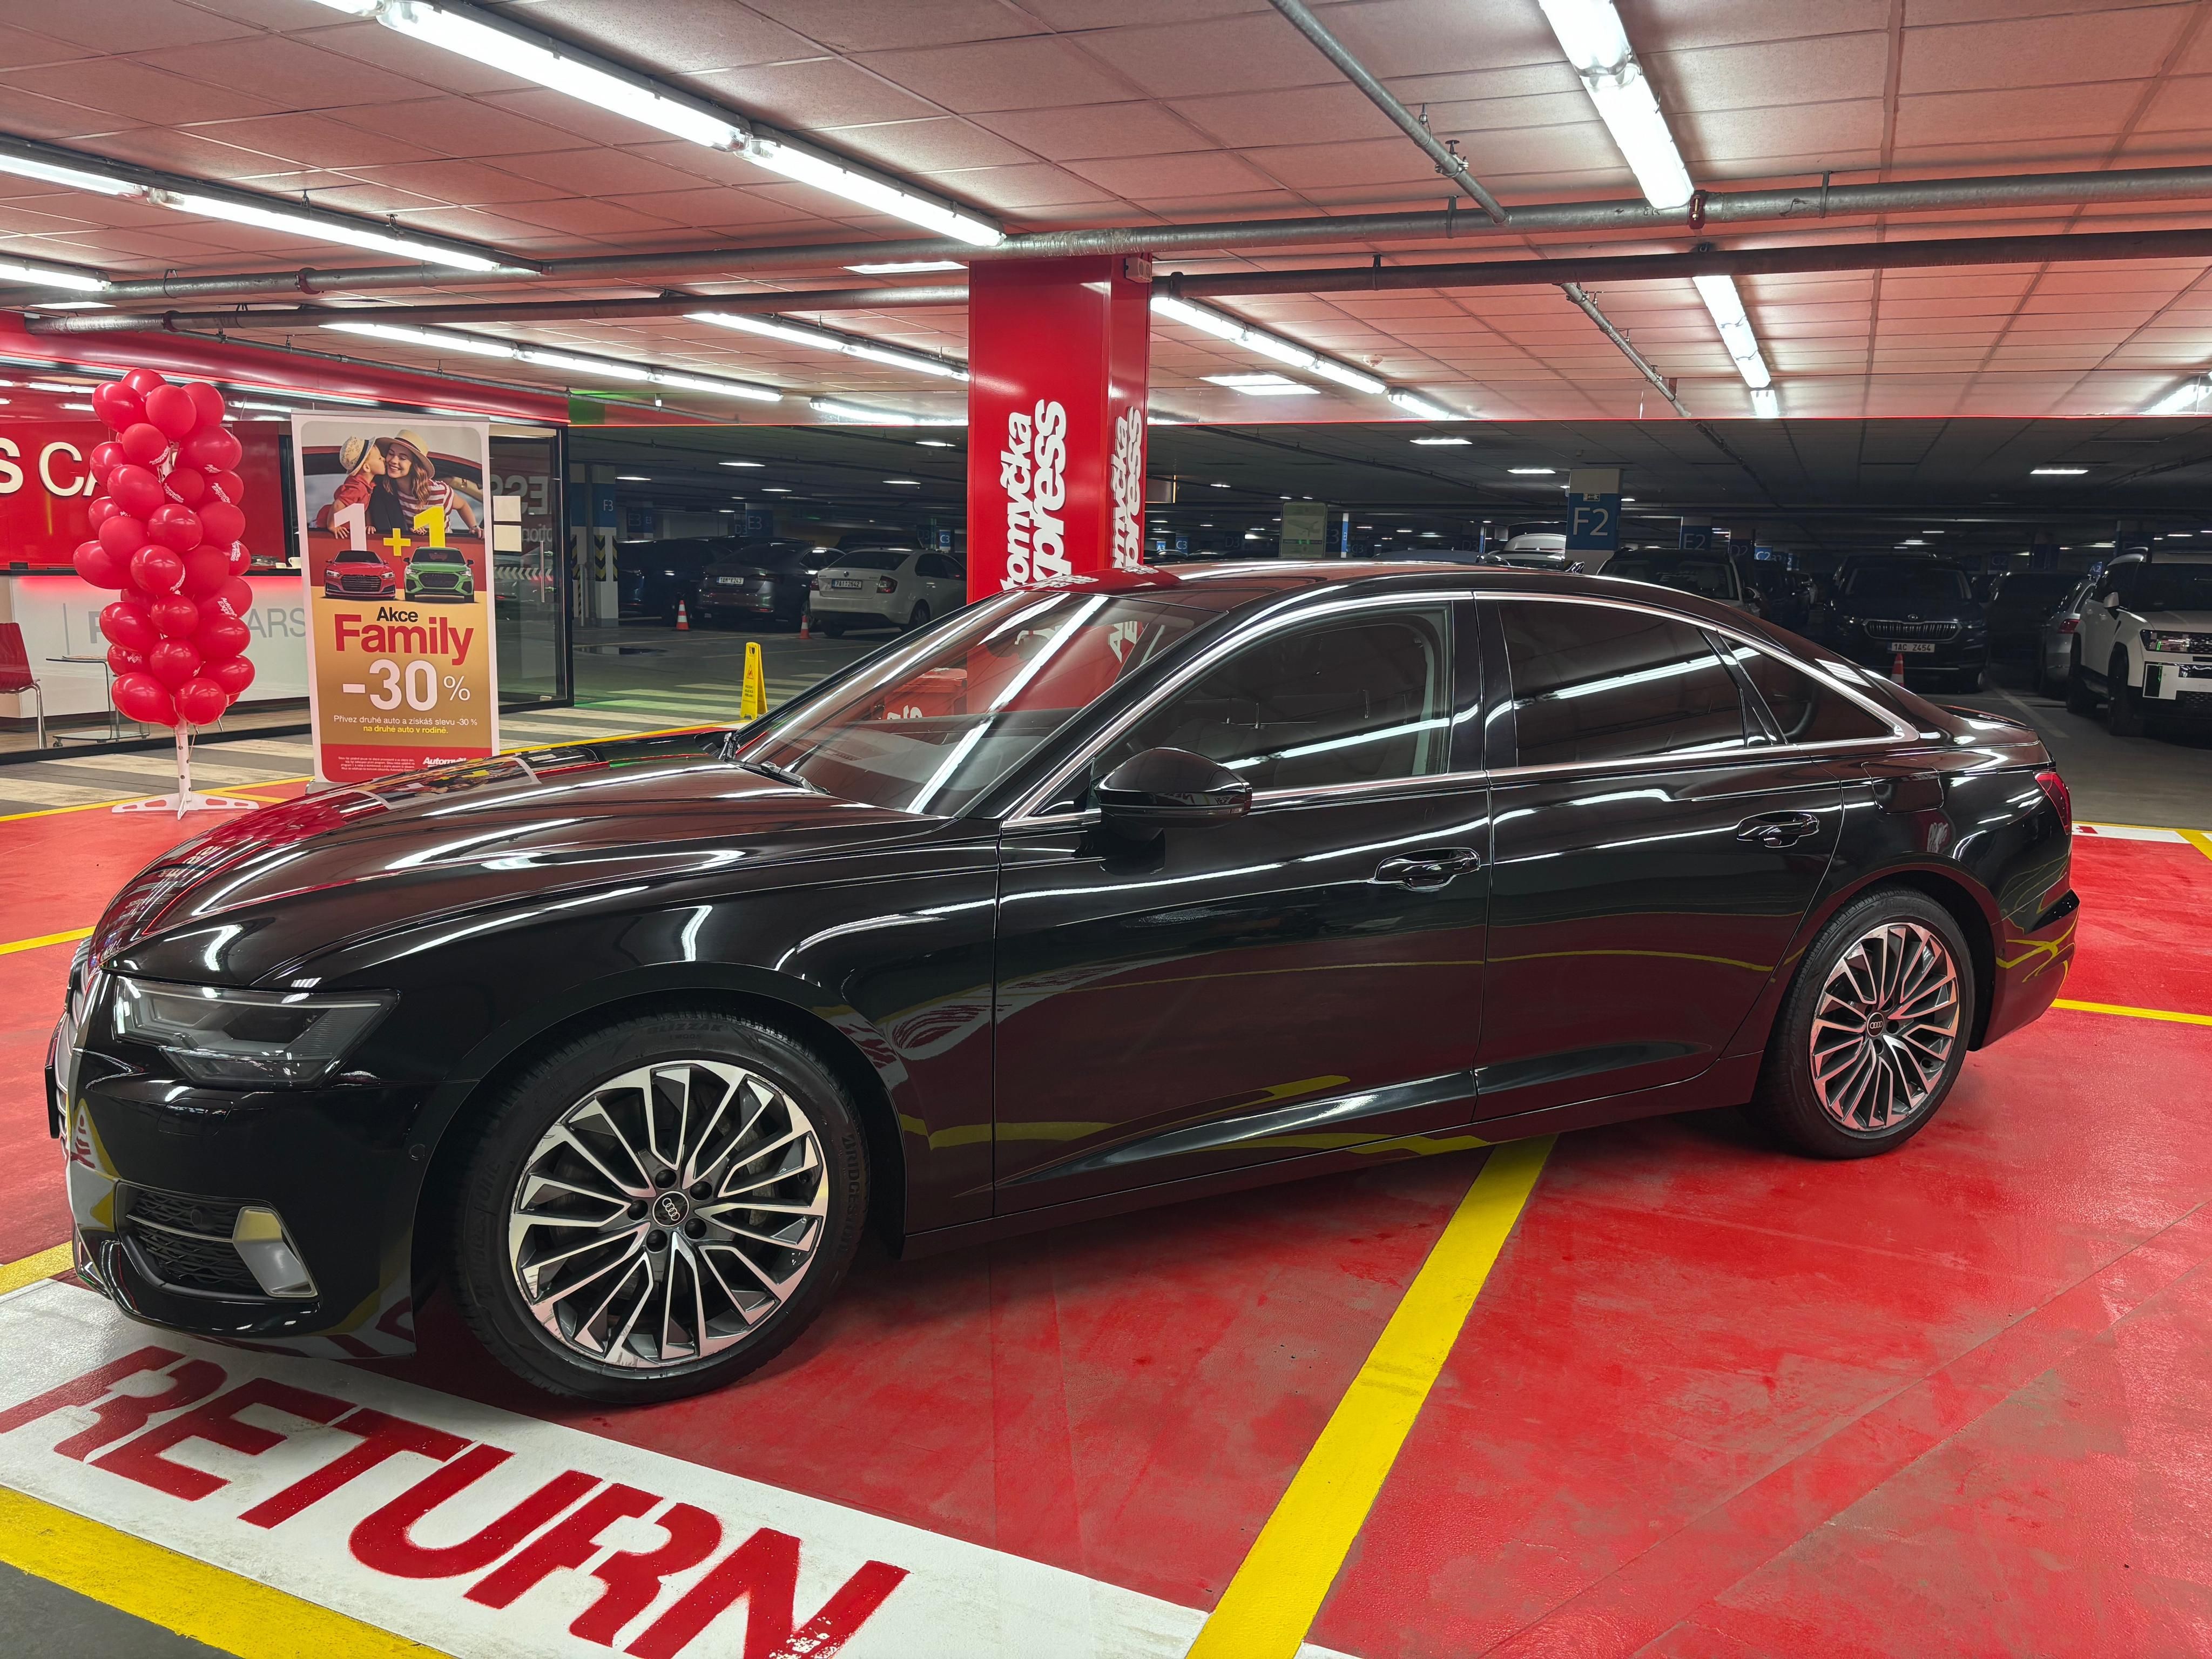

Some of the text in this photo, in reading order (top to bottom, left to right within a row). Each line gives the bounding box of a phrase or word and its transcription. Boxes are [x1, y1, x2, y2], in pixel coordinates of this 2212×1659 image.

[603, 500, 613, 511] F3
[999, 412, 1032, 591] tomyčka
[748, 516, 763, 530] E3
[1573, 507, 1609, 536] F2
[940, 535, 950, 544] C3
[1176, 541, 1188, 550] C3
[1225, 536, 1240, 548] D3
[1682, 533, 1706, 550] E2
[1730, 544, 1748, 557] D2
[1756, 551, 1771, 561] C2
[376, 606, 419, 622] Akce
[247, 608, 306, 638] ARS
[334, 613, 474, 666] Family
[342, 659, 470, 711] -30 %
[334, 715, 357, 723] Přivez
[359, 716, 382, 724] druhé
[409, 717, 433, 725] získáš
[374, 725, 396, 733] druhé
[0, 1345, 909, 1659] RETURN
